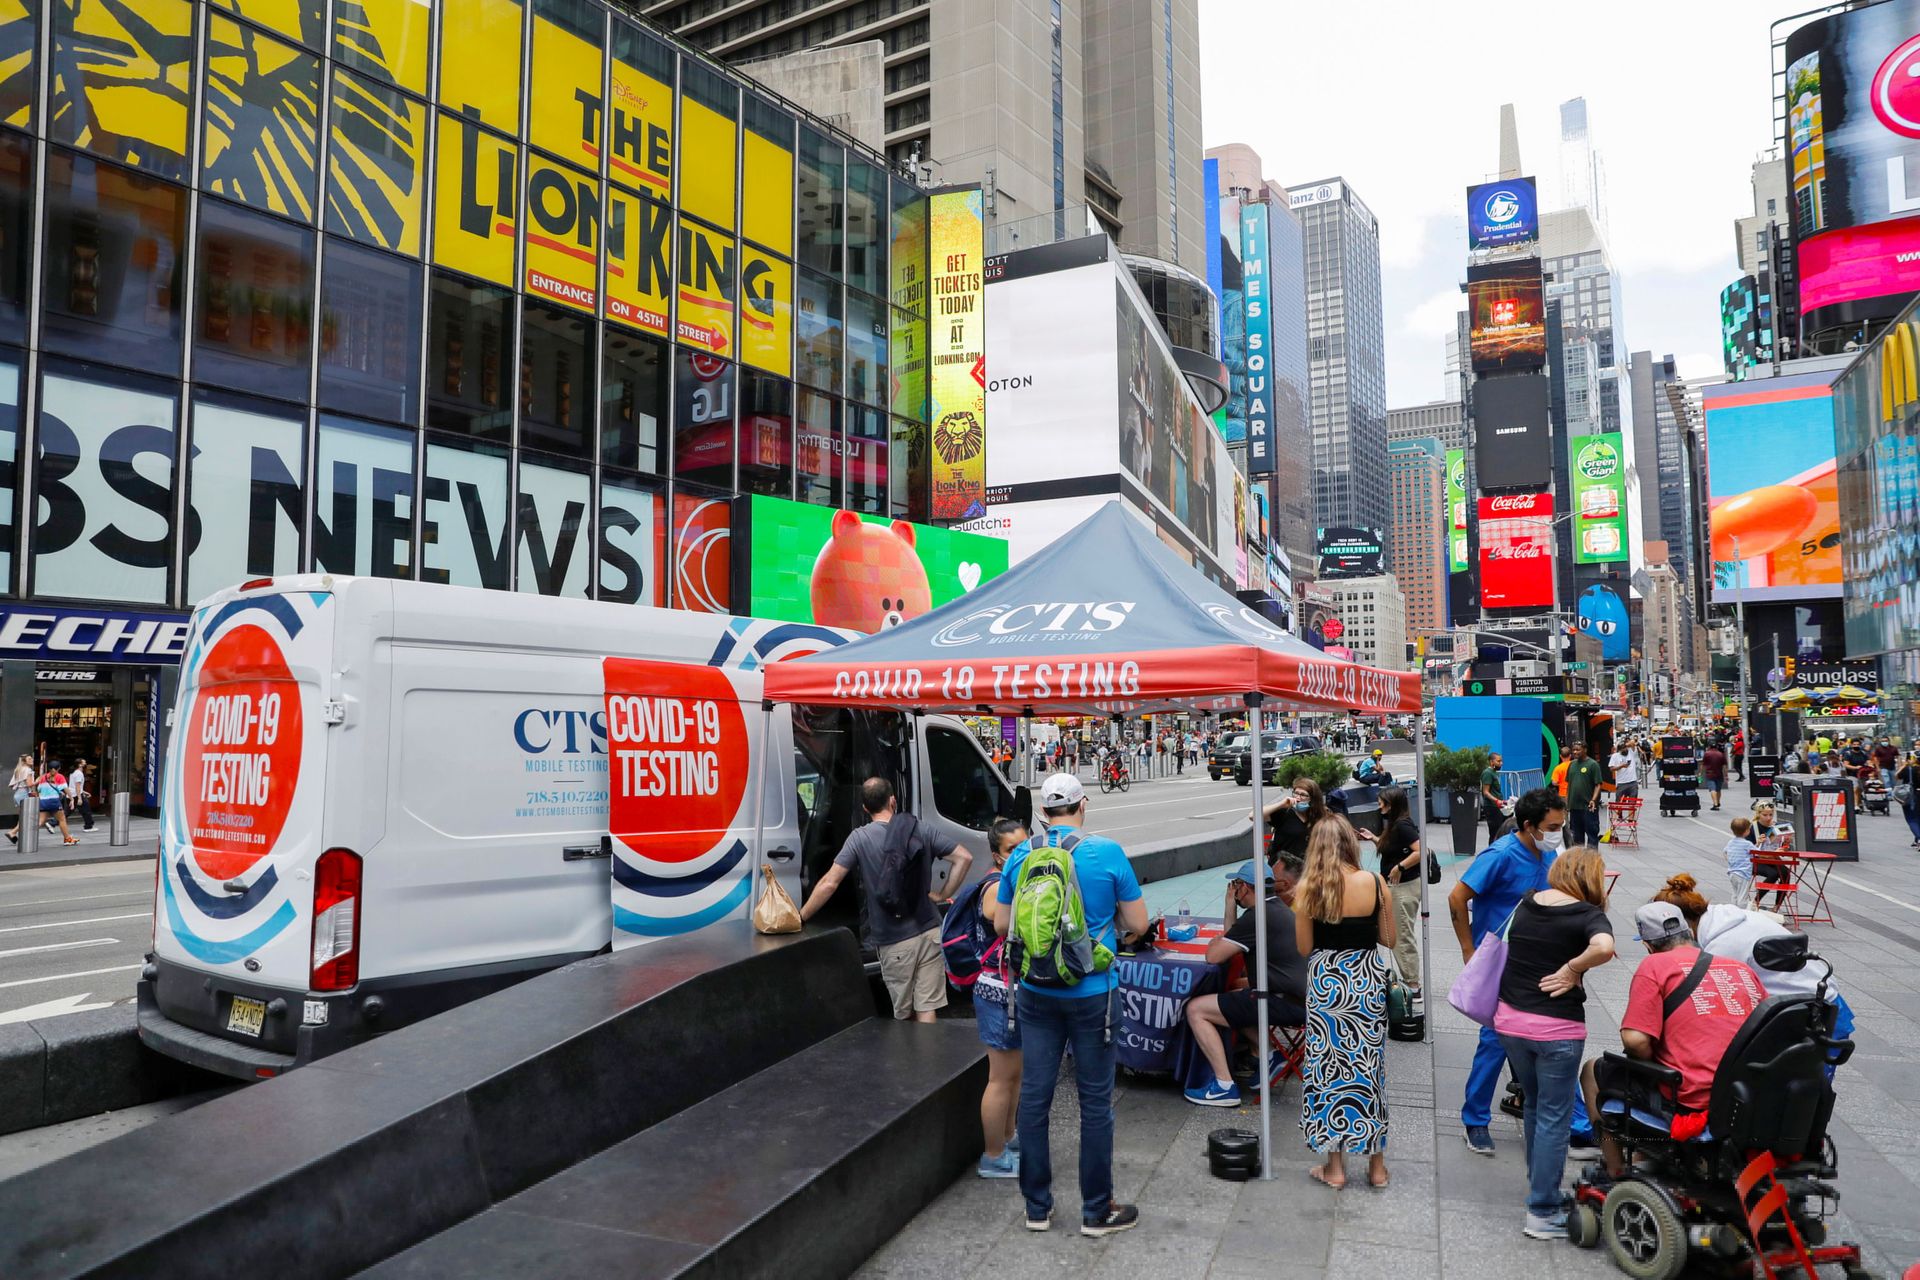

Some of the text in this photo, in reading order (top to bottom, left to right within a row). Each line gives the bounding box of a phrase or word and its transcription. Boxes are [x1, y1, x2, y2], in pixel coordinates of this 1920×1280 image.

[574, 87, 670, 177] THE
[459, 103, 775, 318] LION KING
[1483, 219, 1523, 233] Prudential
[946, 253, 967, 273] GET
[934, 272, 980, 295] TICKETS
[531, 273, 711, 345] ENTRANCE ON 45TH STREET
[939, 294, 975, 315] TODAY
[950, 325, 964, 344] AT
[1244, 217, 1266, 459] TIMES SQUARE
[934, 351, 981, 366] LIONKING.COM
[985, 375, 1033, 393] OTON
[1495, 426, 1527, 435] SAMSUNG
[1583, 458, 1616, 469] Green
[1586, 466, 1616, 477] Giant
[246, 445, 643, 606] NEWS
[988, 602, 1137, 634] CTS
[0, 611, 190, 655] ECHE
[988, 631, 1101, 645] MOBILE TESTING
[35, 670, 98, 681] CHERS
[832, 660, 1140, 700] COVID-19 TESTING
[1297, 662, 1401, 709] COVID-19 TESTING
[1797, 667, 1877, 688] sunglass
[1515, 685, 1549, 693] SERVICES
[201, 692, 281, 746] COVID-19
[608, 694, 721, 745] COVID-19
[1821, 706, 1849, 716] Cold
[146, 678, 161, 798] SKECHERS
[513, 708, 609, 755] CTS
[525, 759, 609, 773] MOBILE TESTING
[615, 749, 719, 797] TESTING
[200, 752, 271, 807] TESTING
[526, 790, 609, 805] 718.510.7220
[207, 811, 255, 828] 718.510.7220
[193, 827, 267, 845] WWW.CTSMOBLETESTING.COM
[1115, 959, 1193, 995] OVID-19
[1126, 1032, 1166, 1053] CTS
